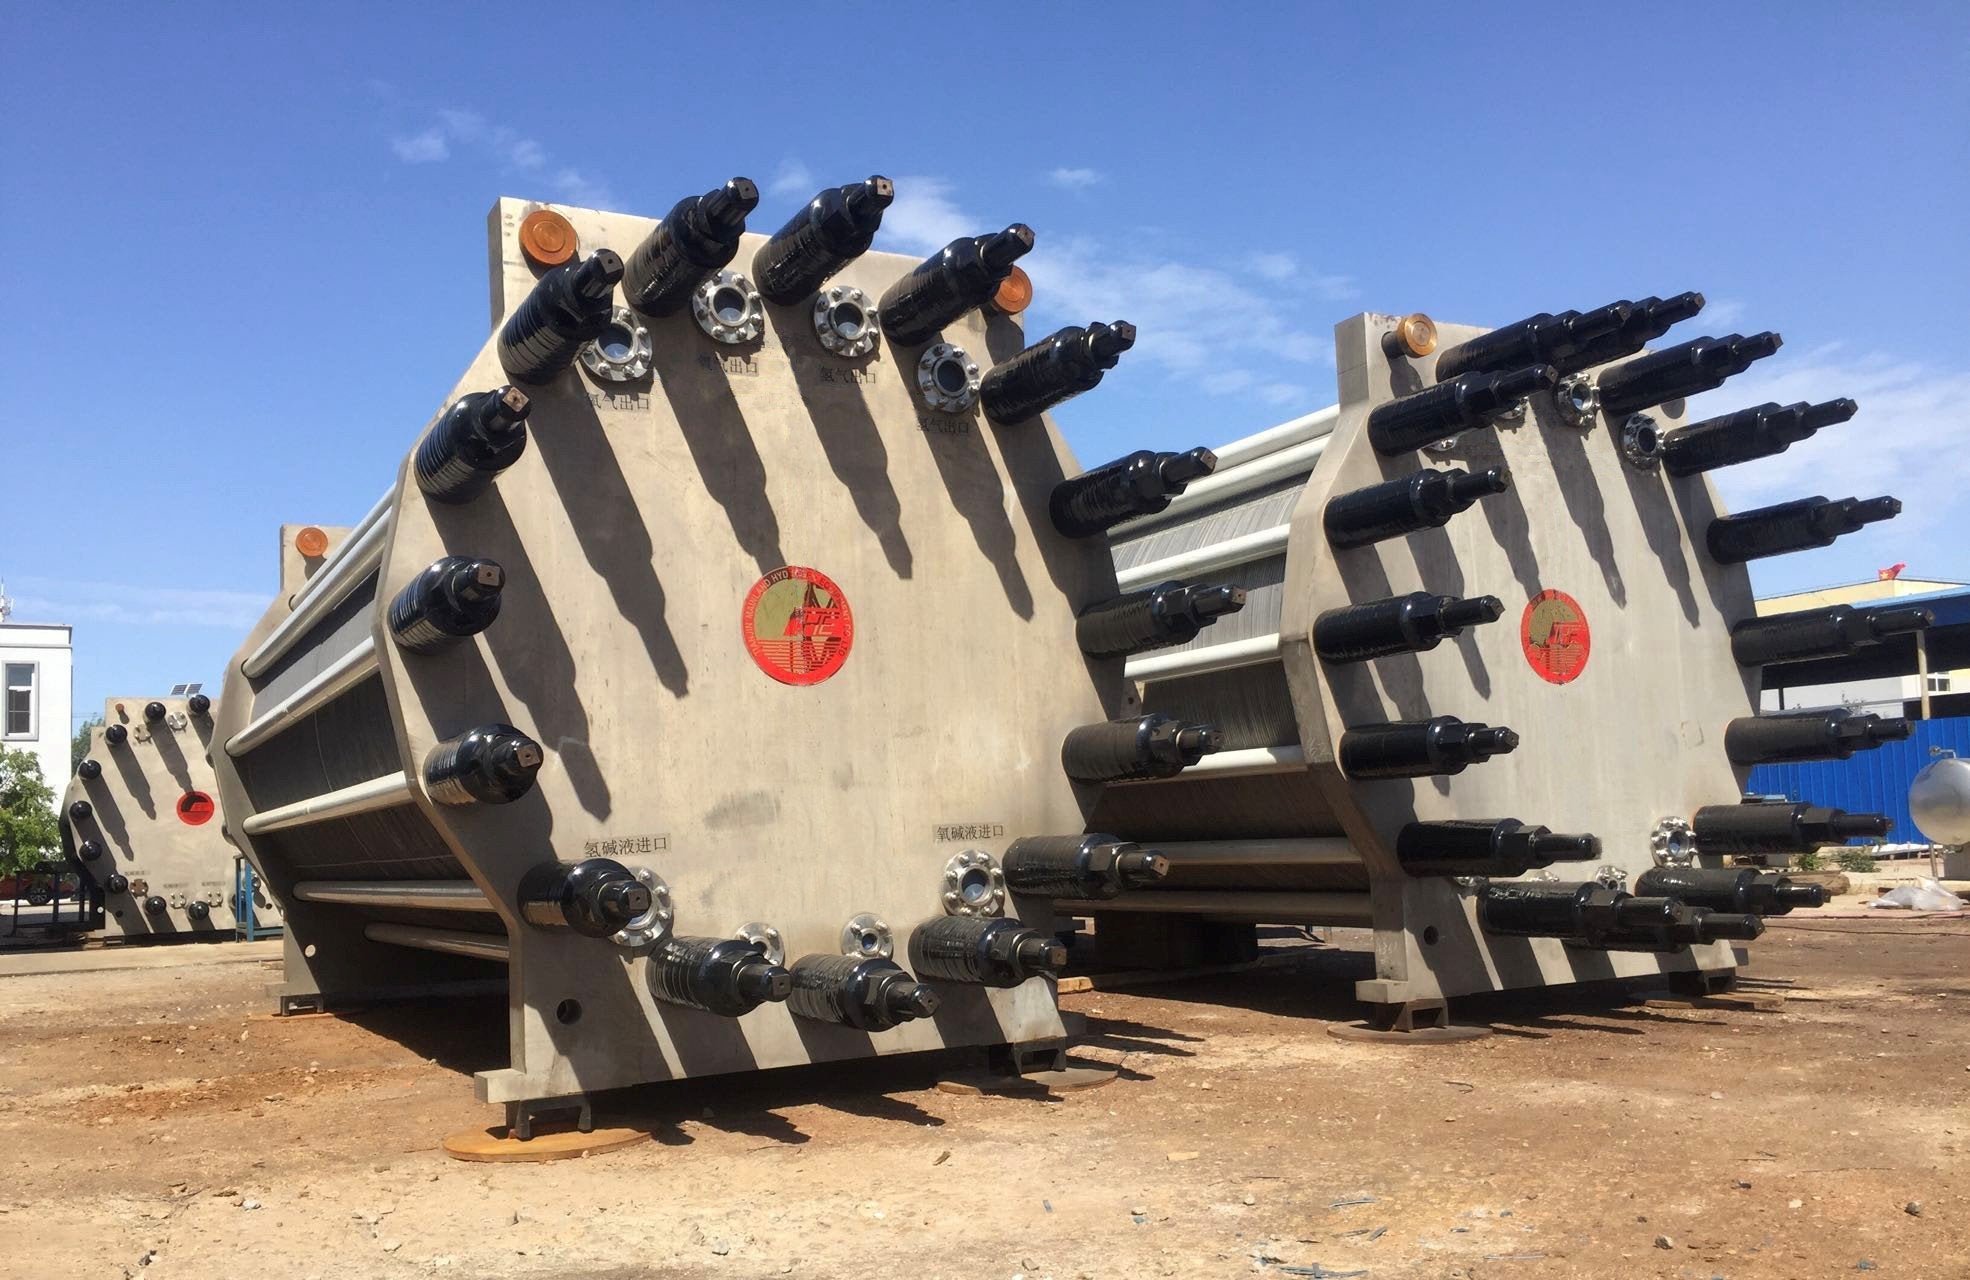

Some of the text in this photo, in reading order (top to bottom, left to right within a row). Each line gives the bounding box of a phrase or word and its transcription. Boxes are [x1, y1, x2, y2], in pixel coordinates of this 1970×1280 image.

[936, 824, 1004, 841] 氧碱液进口
[584, 836, 667, 858] 氢碱液进口
